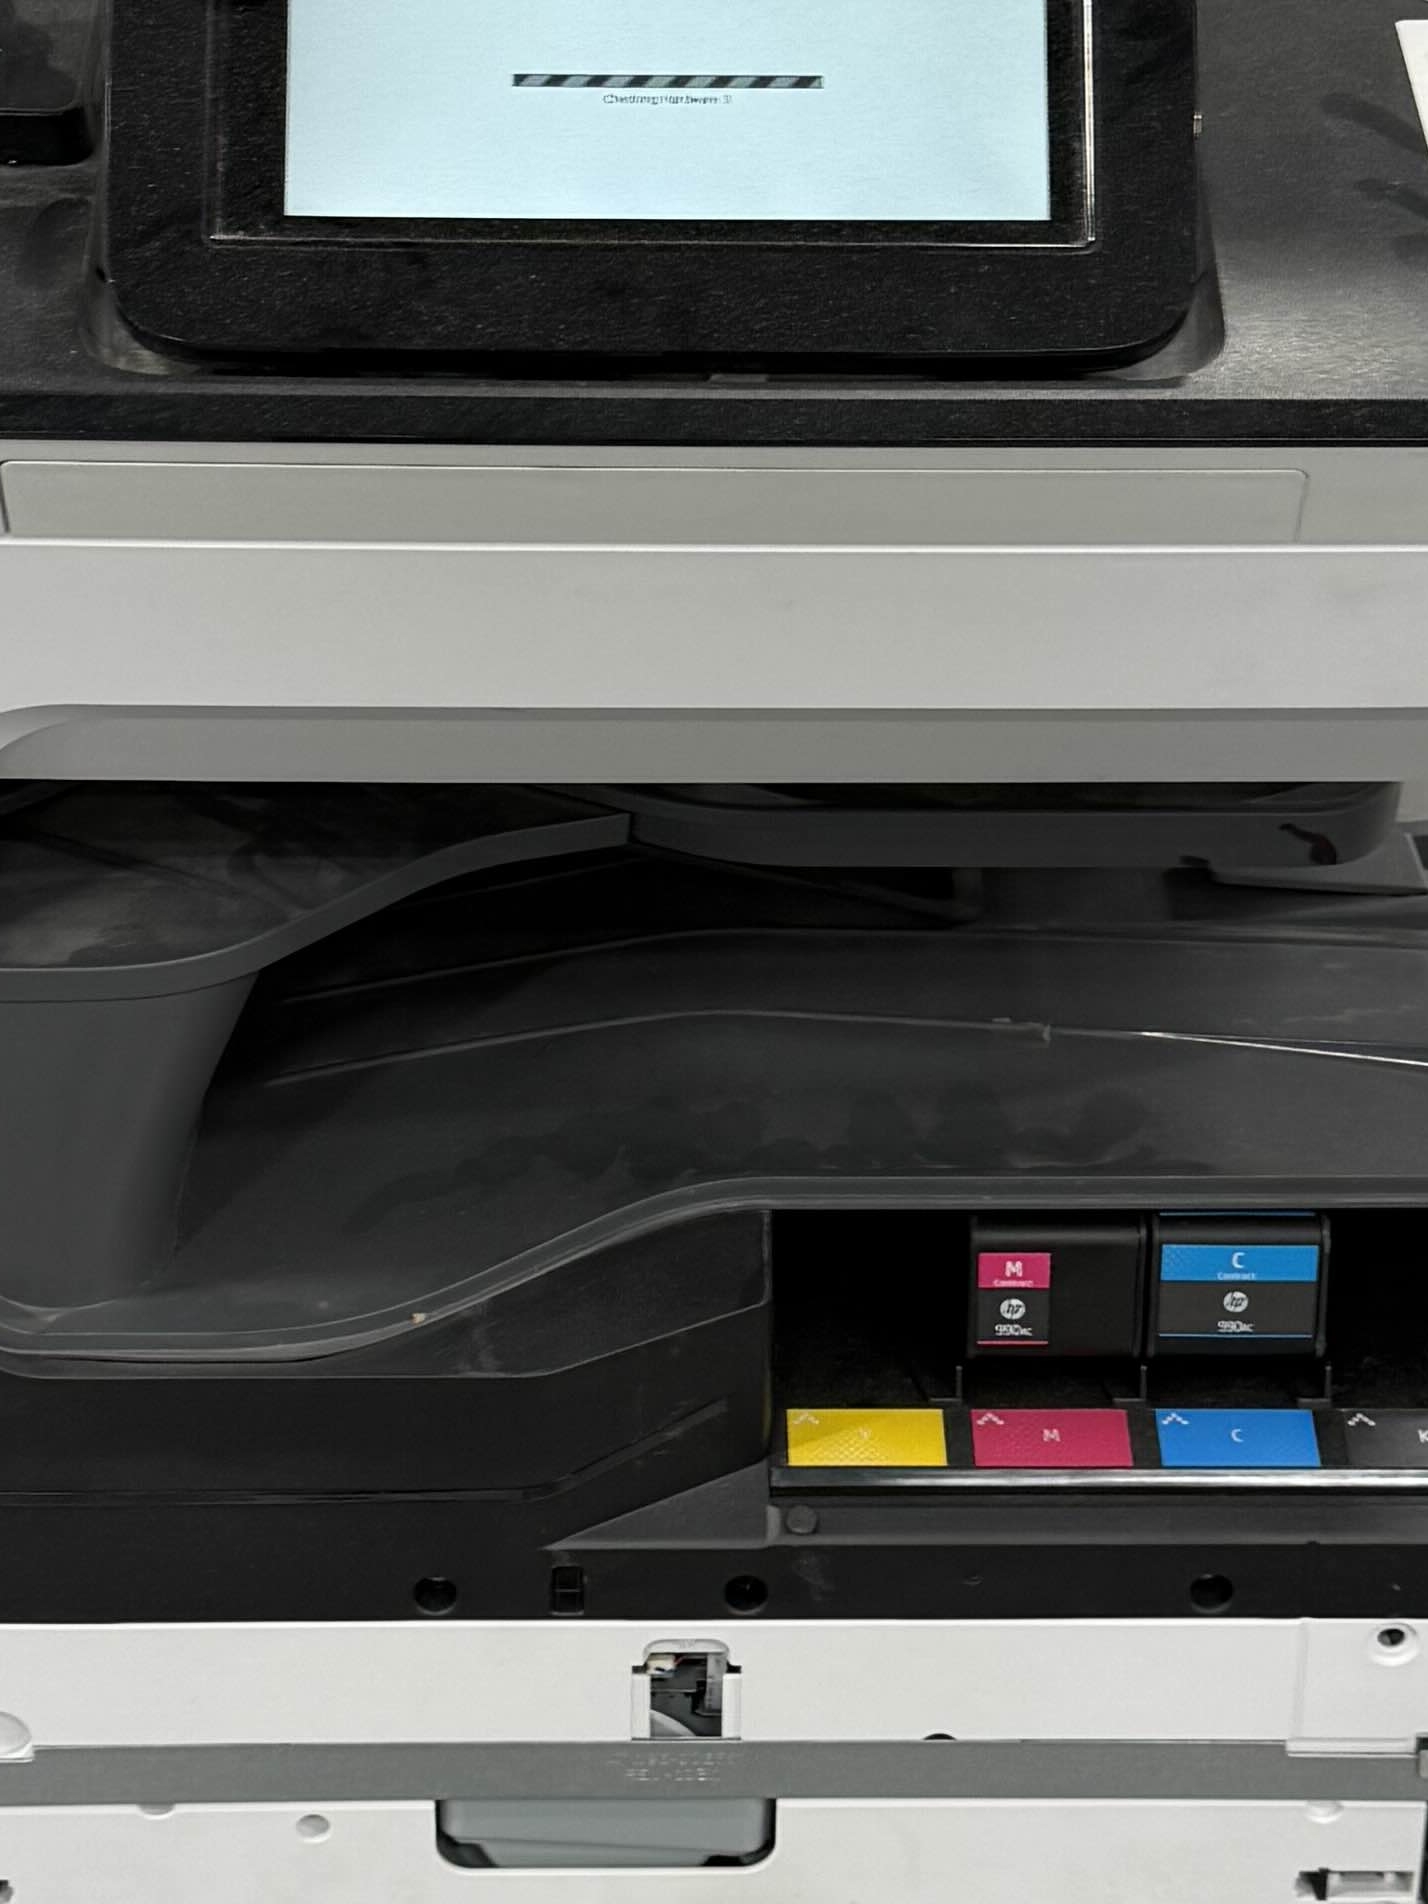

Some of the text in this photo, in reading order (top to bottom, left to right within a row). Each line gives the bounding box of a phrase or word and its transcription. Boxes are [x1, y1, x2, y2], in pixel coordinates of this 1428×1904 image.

[1231, 1252, 1246, 1269] C
[1005, 1260, 1023, 1277] M
[1042, 1428, 1061, 1442] M
[1230, 1428, 1244, 1442] C
